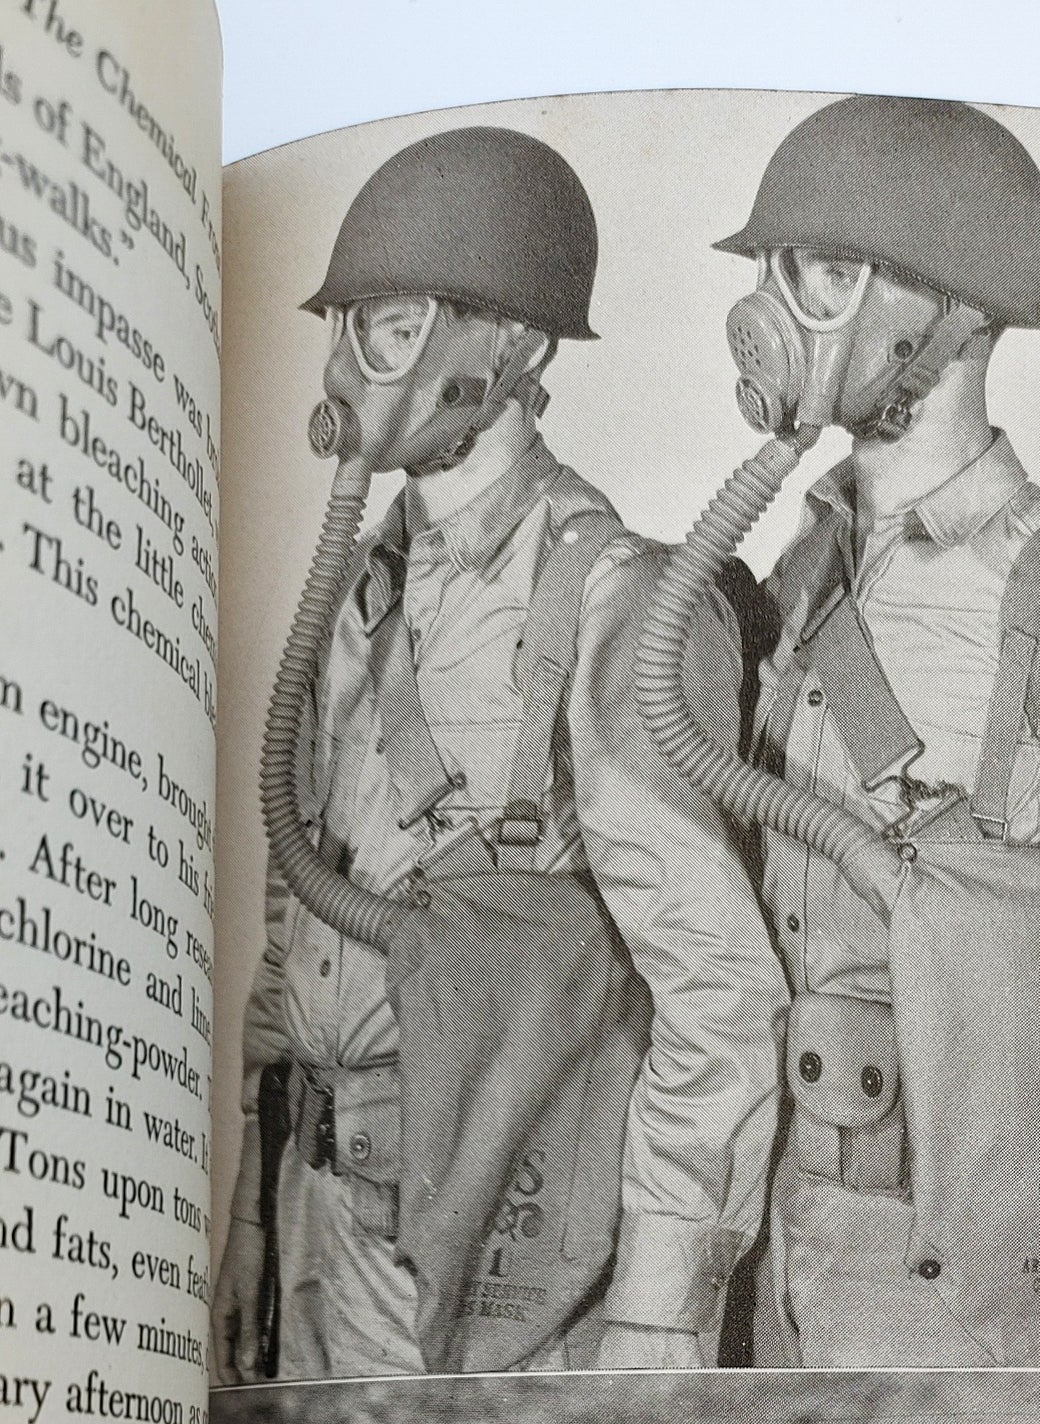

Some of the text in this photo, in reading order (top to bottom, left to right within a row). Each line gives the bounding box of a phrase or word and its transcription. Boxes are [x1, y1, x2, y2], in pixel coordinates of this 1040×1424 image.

[33, 97, 73, 148] of
[80, 120, 191, 290] England,
[96, 49, 197, 205] Chemical
[54, 249, 165, 383] impasse
[173, 373, 202, 438] was
[27, 298, 118, 408] Louis
[128, 380, 214, 538] Berthollet,
[59, 392, 185, 556] bleaching
[16, 458, 52, 504] at
[73, 485, 122, 550] the
[135, 523, 184, 609] little
[22, 521, 98, 606] This
[111, 587, 201, 702] chemical
[40, 699, 148, 793] engine,
[22, 752, 50, 802] it
[69, 787, 134, 845] over
[148, 825, 169, 868] to
[178, 838, 200, 897] his
[28, 833, 117, 907] After
[130, 874, 178, 960] long
[0, 896, 131, 986] chlorine
[145, 972, 183, 1017] and
[0, 1062, 92, 1118] again
[106, 1085, 133, 1131] in
[144, 1111, 198, 1163] water.
[0, 1126, 86, 1191] Tons
[102, 1167, 165, 1219] upon
[173, 1187, 201, 1233] tons
[52, 1213, 118, 1280] fats,
[131, 1251, 180, 1289] even
[36, 1302, 56, 1335] a
[70, 1292, 126, 1346] few
[137, 1316, 204, 1376] minutes,
